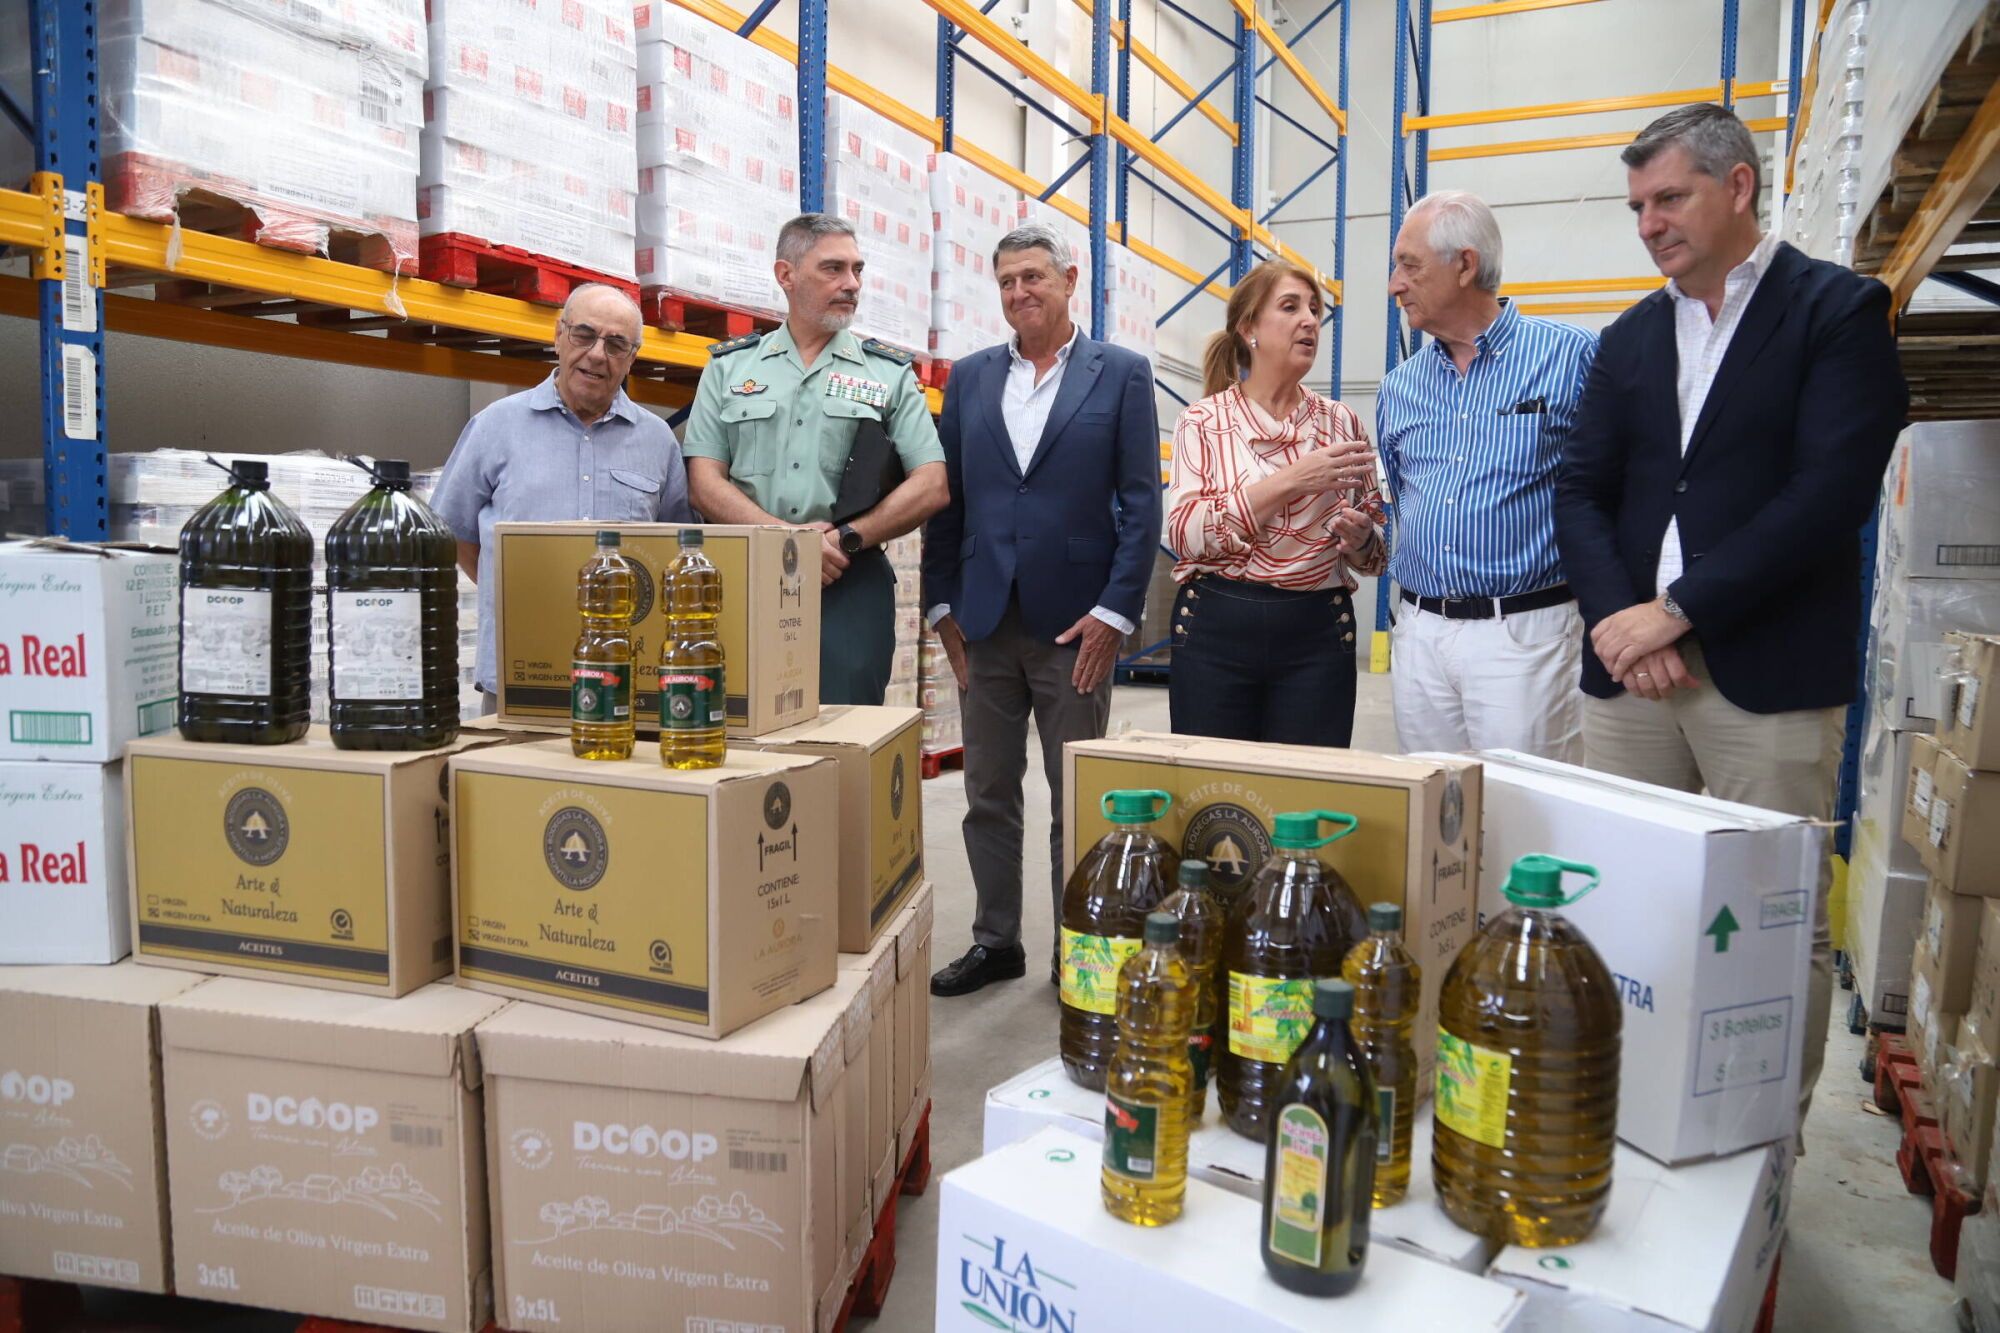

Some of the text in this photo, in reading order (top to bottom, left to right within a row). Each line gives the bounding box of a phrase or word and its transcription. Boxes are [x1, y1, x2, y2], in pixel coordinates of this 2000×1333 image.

[0, 573, 36, 597] irgen
[22, 633, 87, 678] Real
[1177, 782, 1274, 819] ACEITE DE OLIV
[764, 839, 792, 857] FRAGIL
[1188, 809, 1270, 862] BODEGAS LA AURORA
[20, 840, 87, 885] Real
[236, 874, 265, 892] Arte
[222, 898, 298, 923] Naturaleza
[554, 898, 583, 918] Arte
[239, 941, 284, 956] ACEITES
[538, 923, 616, 952] Naturaleza
[555, 969, 600, 987] ACEITES
[1612, 973, 1654, 1013] TRA
[1723, 1013, 1783, 1039] Botellas
[0, 1071, 75, 1106] OOP
[0, 1202, 124, 1229] liva Virgen Extra
[213, 1218, 429, 1262] Aceite de Oliva Virgen Extra
[198, 1263, 240, 1290] 3x5L
[532, 1250, 770, 1293] Aceite de Oliva Virgen Extra
[992, 1235, 1041, 1292] LA
[516, 1295, 560, 1323] 3x5L
[960, 1257, 1077, 1333] UNION
